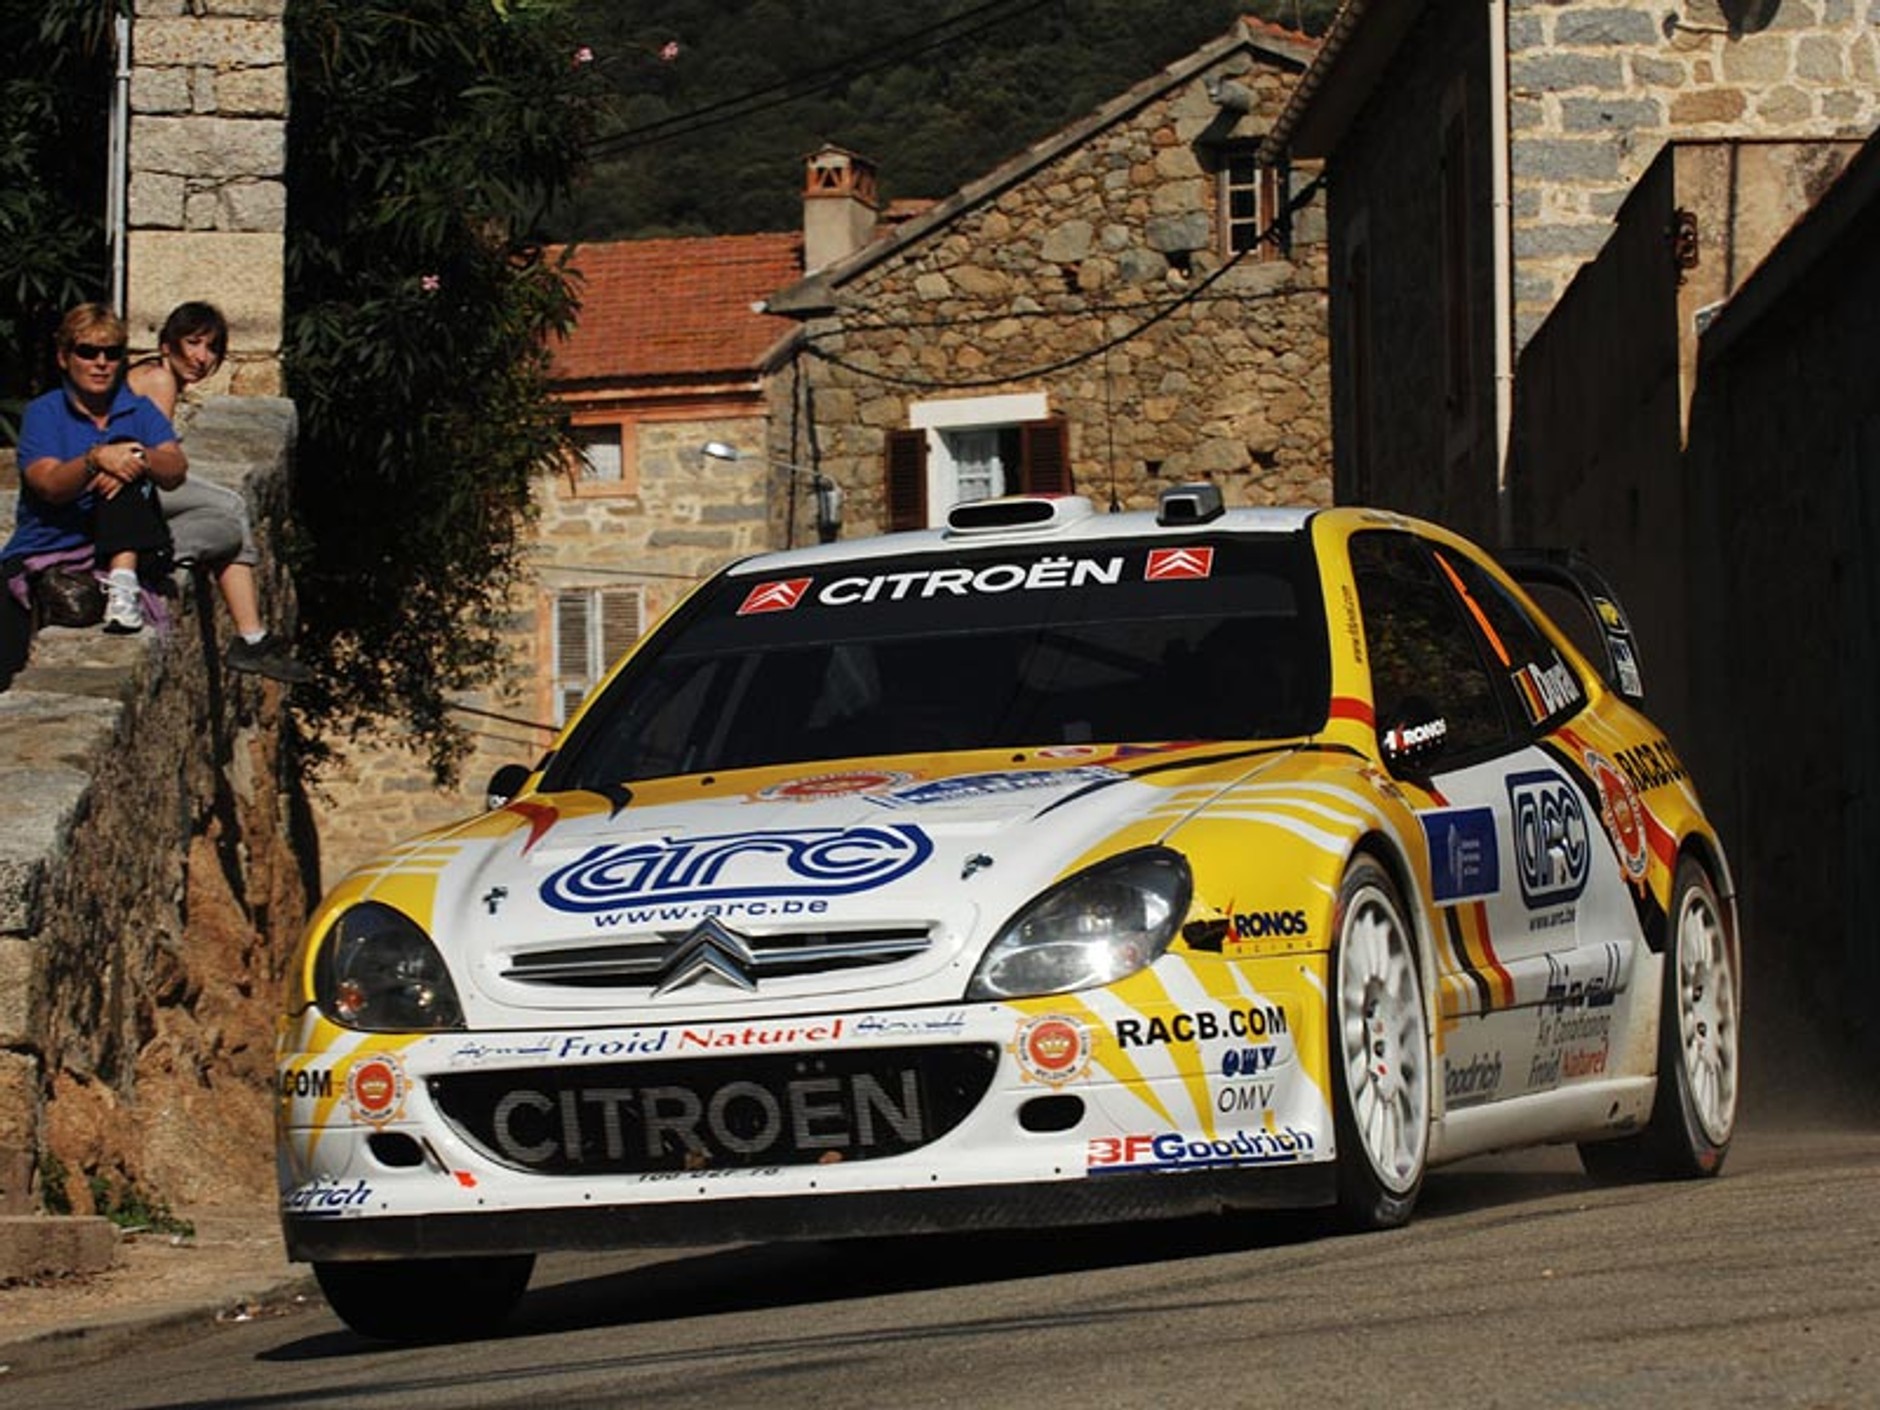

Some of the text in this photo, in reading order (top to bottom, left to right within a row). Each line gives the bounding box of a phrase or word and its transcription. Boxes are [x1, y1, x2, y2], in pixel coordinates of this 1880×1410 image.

[818, 556, 1123, 605] CITROËN
[594, 899, 828, 928] www.arc.be
[559, 1030, 668, 1058] Froid
[678, 1018, 843, 1049] Naturel
[1115, 1005, 1288, 1048] RACB.COM
[494, 1060, 924, 1163] CITROËN
[1217, 1084, 1274, 1113] OMV
[1088, 1127, 1313, 1165] BFGoodrich
